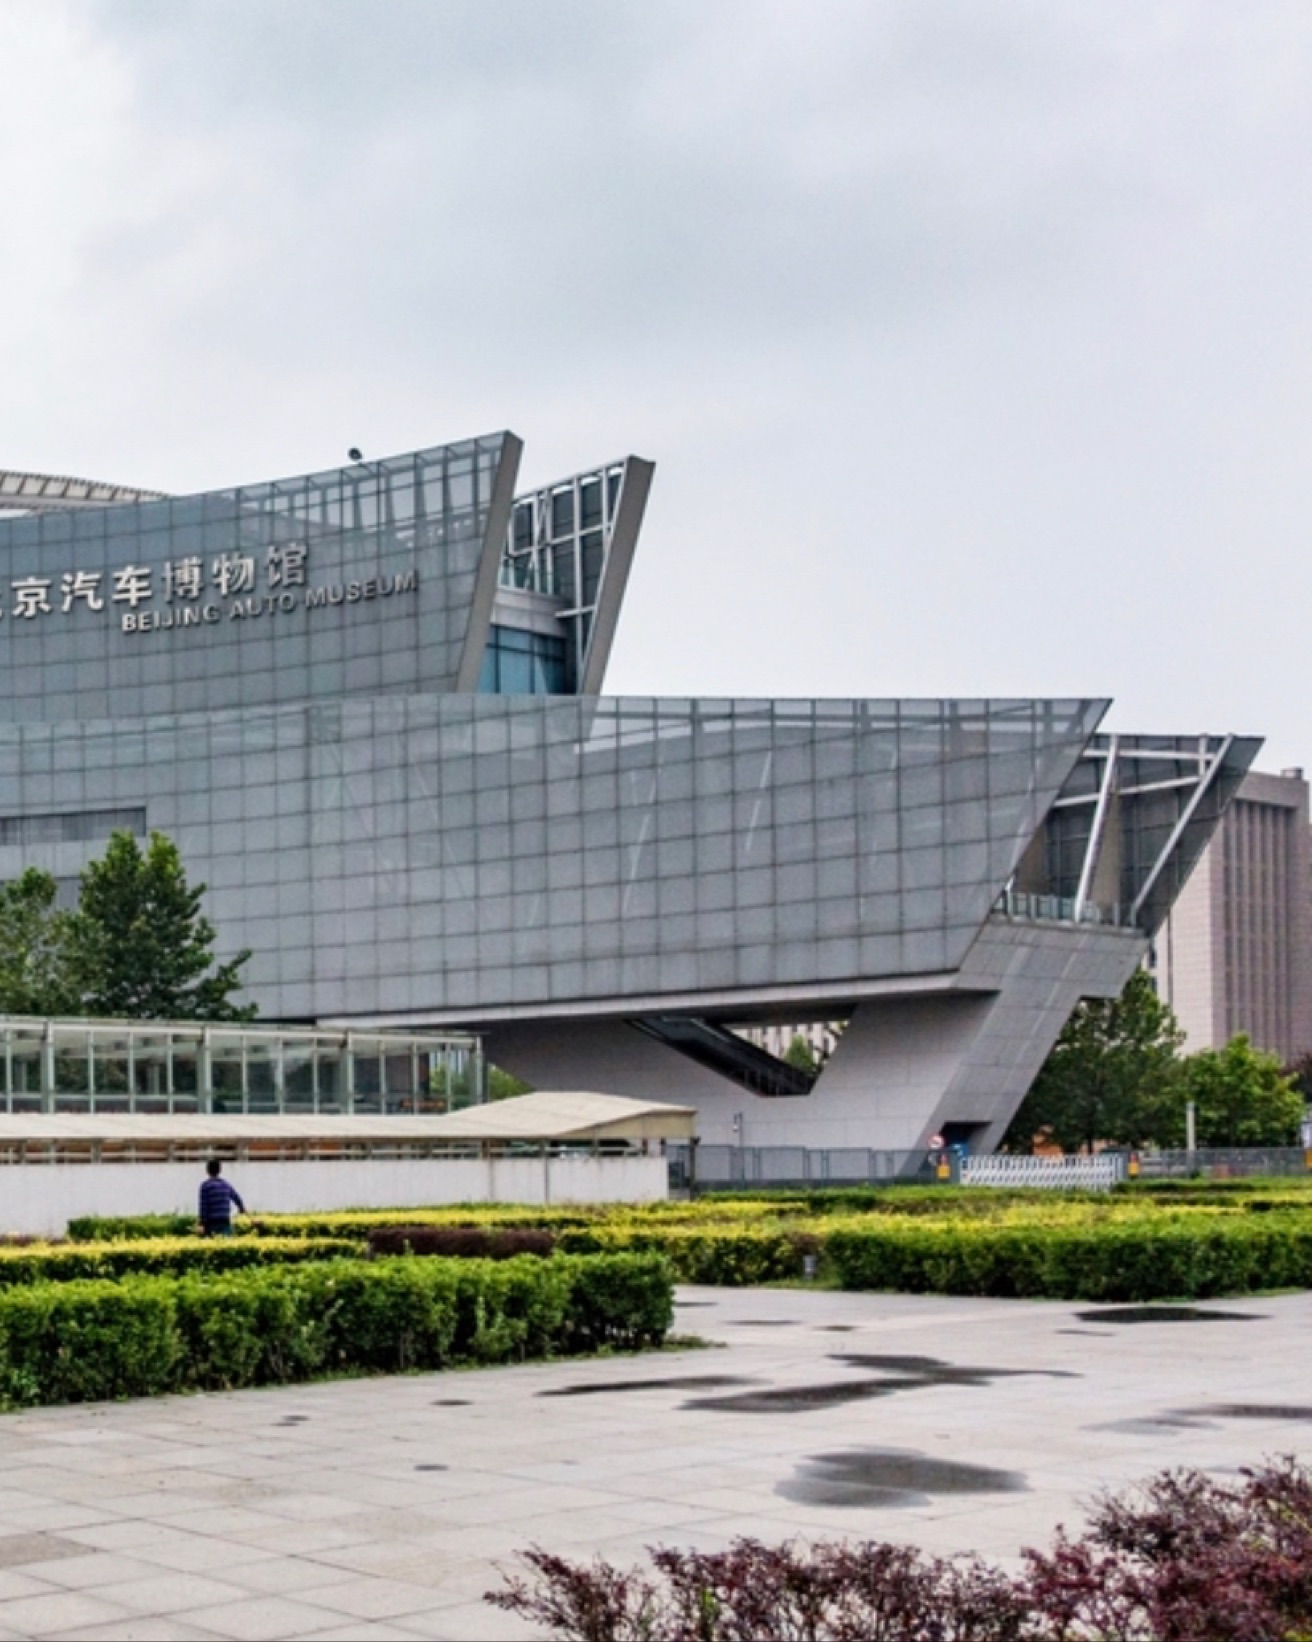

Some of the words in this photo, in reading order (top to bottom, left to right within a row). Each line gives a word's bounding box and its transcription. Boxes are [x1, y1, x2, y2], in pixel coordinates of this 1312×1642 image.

[121, 604, 220, 634] BEIJING
[228, 591, 294, 621] AUTO
[305, 570, 418, 608] MUSEUM
